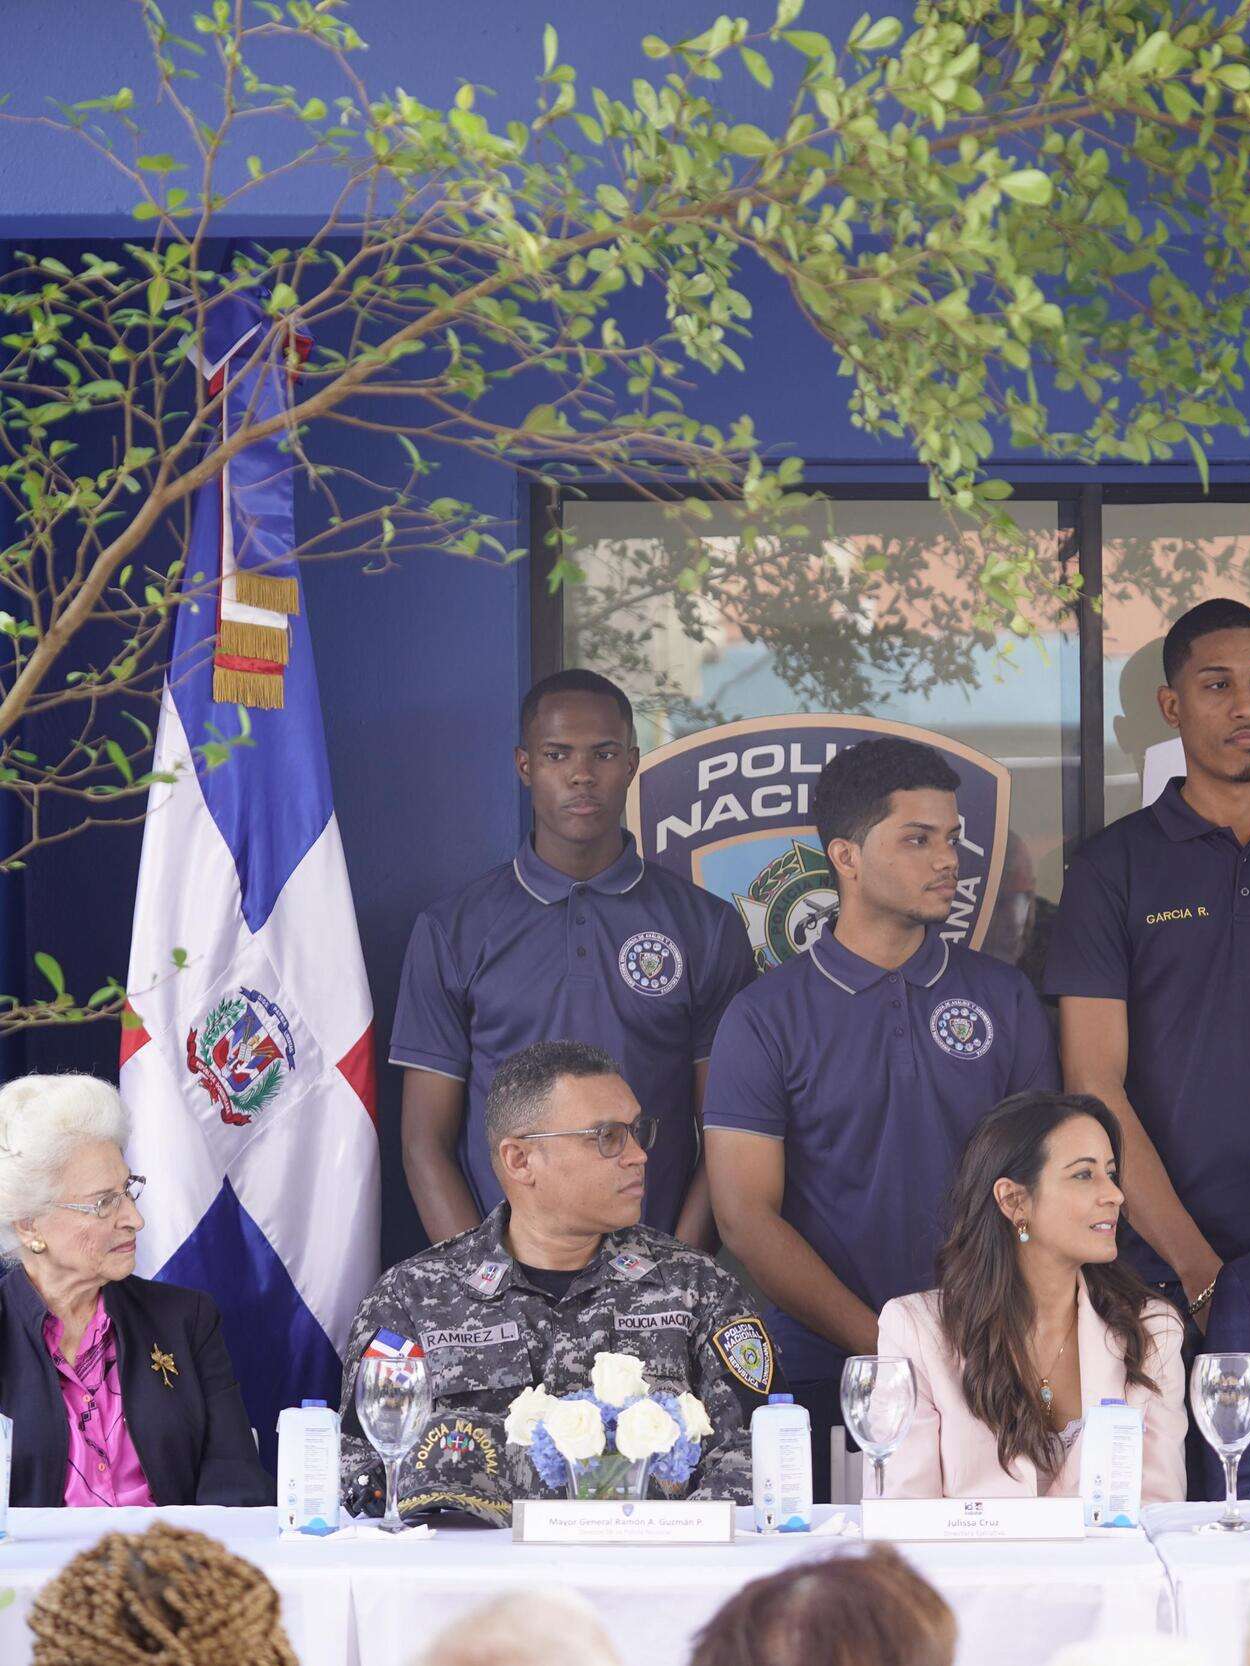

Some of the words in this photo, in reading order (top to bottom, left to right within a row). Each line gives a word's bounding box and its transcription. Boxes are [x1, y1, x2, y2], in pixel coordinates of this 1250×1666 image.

[698, 743, 836, 791] POLI
[1146, 908, 1192, 924] GARCIA
[1197, 906, 1209, 916] R.
[618, 1317, 658, 1328] POLICIA
[724, 1323, 754, 1341] POLICIA
[427, 1330, 493, 1347] RAMIREZ
[500, 1327, 514, 1339] L.
[723, 1331, 763, 1351] NACIONAL
[728, 1355, 759, 1388] REPUBLICA
[416, 1422, 449, 1471] POLICIA
[455, 1419, 498, 1475] NACIONAL
[549, 1518, 577, 1527] Mayor
[579, 1518, 612, 1526] General
[979, 1518, 1000, 1527] Cruz
